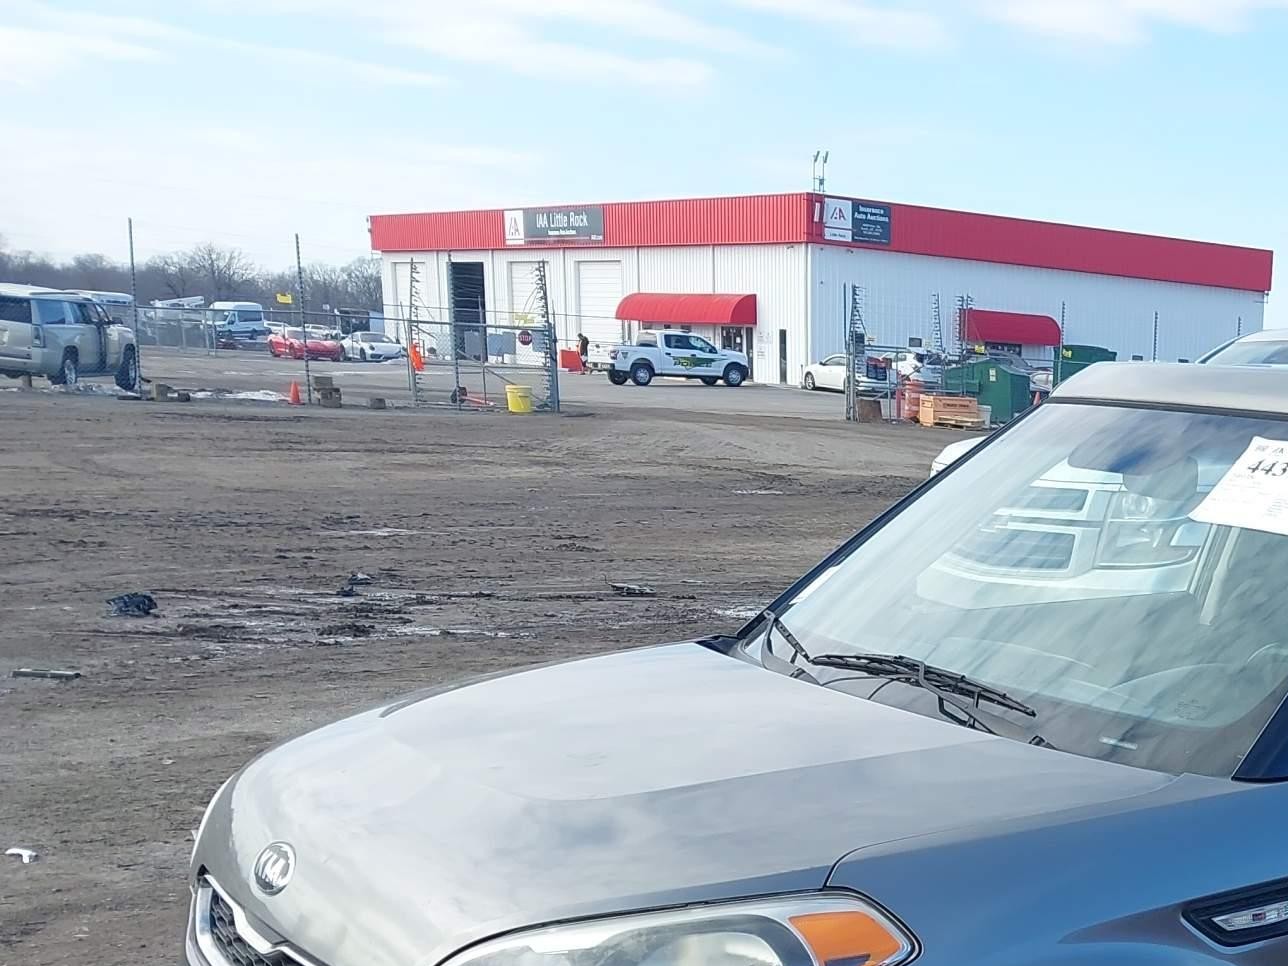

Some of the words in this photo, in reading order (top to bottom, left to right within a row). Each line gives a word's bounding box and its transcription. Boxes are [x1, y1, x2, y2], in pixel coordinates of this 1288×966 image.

[859, 205, 884, 214] Insurance
[536, 213, 549, 228] IAA
[549, 211, 568, 228] Little
[569, 211, 588, 227] Rock
[854, 212, 866, 220] Auto
[867, 213, 889, 222] Auctions
